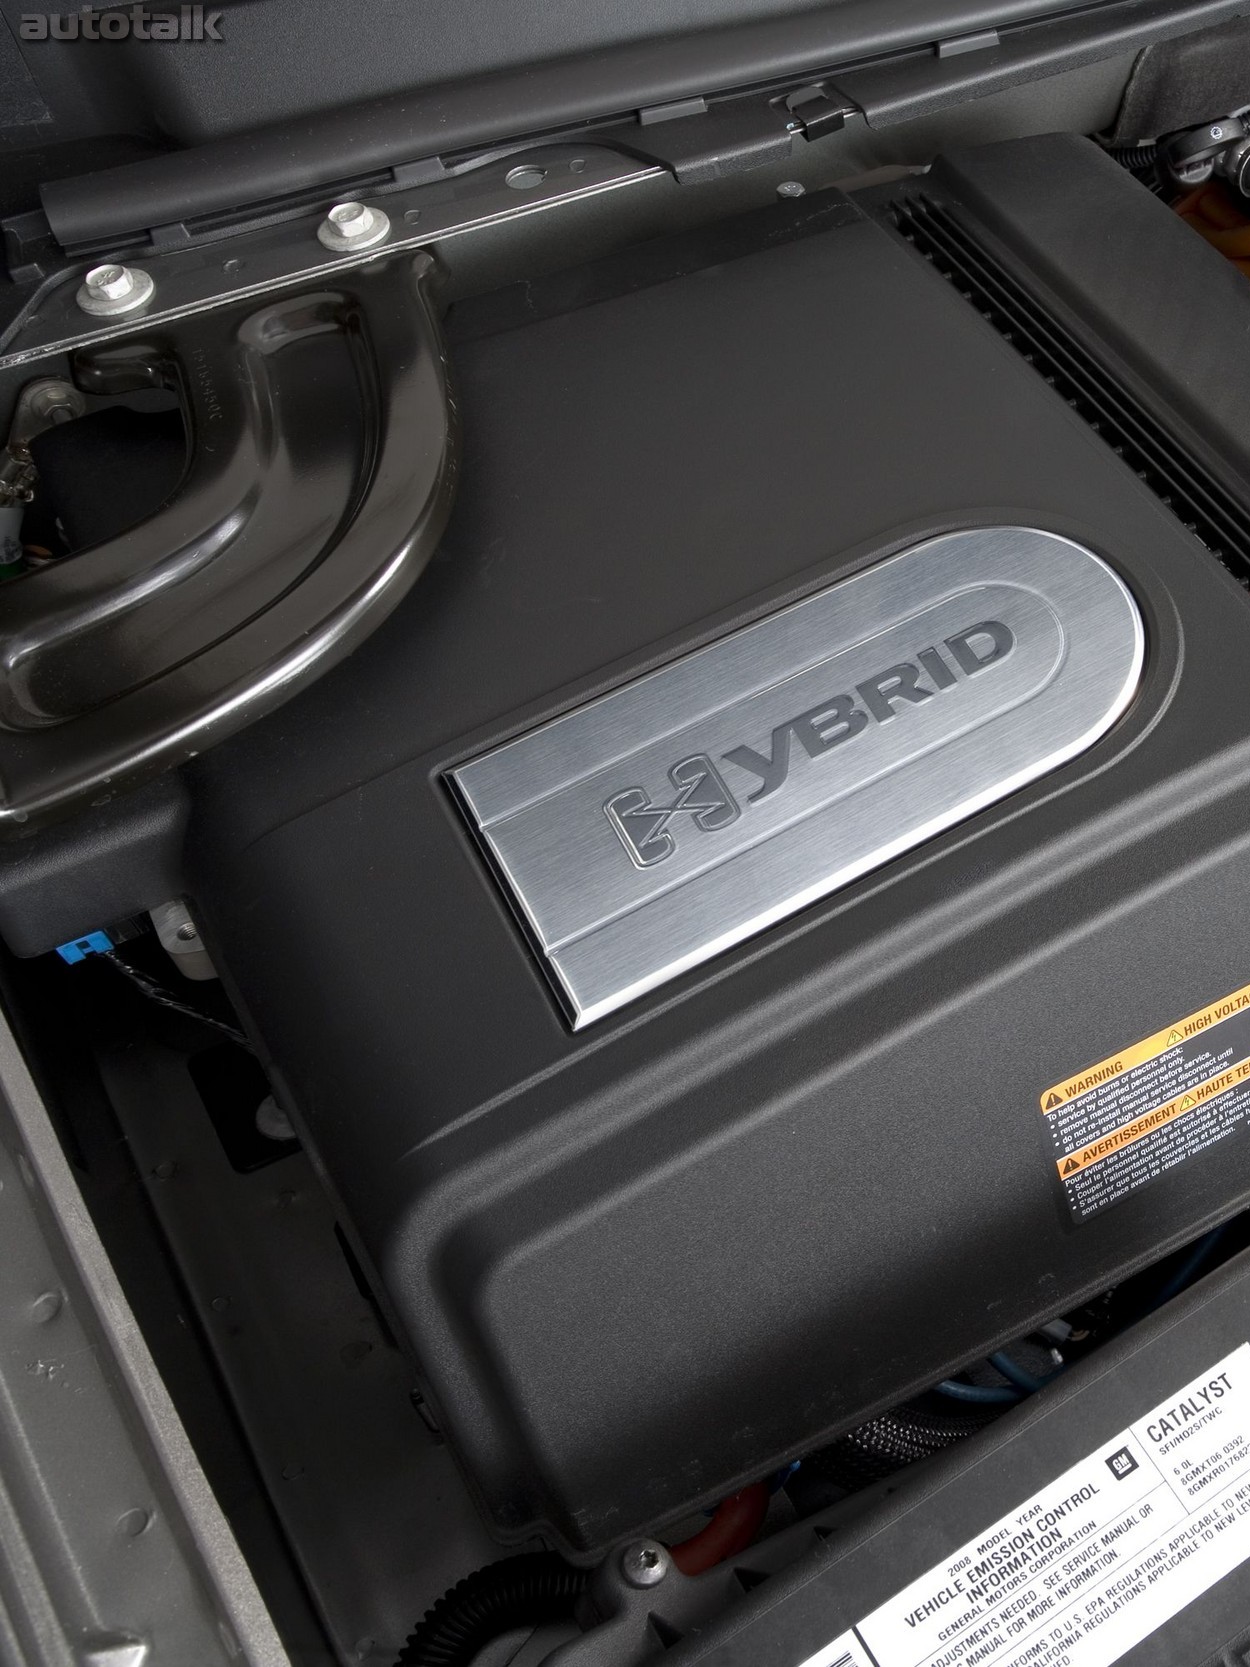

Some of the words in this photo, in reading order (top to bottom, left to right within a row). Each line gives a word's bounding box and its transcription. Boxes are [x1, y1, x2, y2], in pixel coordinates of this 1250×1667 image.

[1046, 1113, 1057, 1122] To
[1057, 1103, 1076, 1117] help
[1076, 1090, 1097, 1108] avoid
[1097, 1080, 1120, 1096] burns
[1120, 1074, 1130, 1084] or
[1130, 1060, 1159, 1079] electric
[1159, 1046, 1184, 1064] shock:
[1057, 1108, 1086, 1127] service
[1086, 1102, 1096, 1112] by
[1097, 1083, 1130, 1107] qualified
[1130, 1063, 1167, 1090] personnel
[1167, 1056, 1185, 1069] only.
[1059, 1116, 1089, 1136] remove
[1089, 1099, 1118, 1120] manual
[1118, 1078, 1159, 1105] disconnect
[1158, 1066, 1183, 1083] before
[1183, 1051, 1212, 1070] service.
[1062, 1135, 1073, 1145] do
[1073, 1126, 1087, 1139] not
[1087, 1107, 1121, 1131] re-install
[1121, 1092, 1150, 1113] manual
[1150, 1079, 1177, 1098] service
[1177, 1056, 1217, 1083] disconnect
[1217, 1047, 1234, 1062] until
[1064, 1060, 1123, 1098] WARNING
[1183, 1013, 1212, 1037] HIGH
[1064, 1142, 1075, 1153] all
[1075, 1129, 1101, 1147] covers
[1101, 1120, 1116, 1134] and
[1116, 1112, 1134, 1125] high
[1134, 1097, 1162, 1115] voltage
[1162, 1083, 1186, 1101] cables
[1186, 1076, 1199, 1088] are
[1199, 1072, 1208, 1080] in
[1208, 1060, 1230, 1077] place.
[1082, 1103, 1176, 1163] AVERTISSEMENT
[1196, 1072, 1234, 1101] HAUTE
[1146, 1372, 1232, 1443] CATALYST
[904, 1578, 966, 1628] VEHICLE
[966, 1528, 1035, 1584] EMISSION
[1036, 1483, 1101, 1532] CONTROL
[937, 1605, 985, 1641] GENERAL
[985, 1571, 1028, 1607] MOTORS
[1028, 1520, 1097, 1574] CORPORATION
[947, 1555, 972, 1578] 2008
[976, 1528, 1011, 1556] MODEL
[1015, 1504, 1043, 1526] YEAR
[965, 1527, 1063, 1604] INFORMATION
[999, 1589, 1041, 1623] NEEDED.
[1042, 1570, 1063, 1590] SEE
[1061, 1541, 1102, 1576] SERVICE
[1100, 1515, 1140, 1547] MANUAL
[1138, 1503, 1154, 1519] OR
[1048, 1628, 1063, 1642] TO
[1063, 1613, 1082, 1632] U.S.
[1084, 1596, 1106, 1615] EPA
[1104, 1548, 1168, 1600] REGULATIONS
[1168, 1509, 1221, 1553] APPLICABLE
[1221, 1498, 1235, 1511] TO
[1082, 1580, 1147, 1633] REGULATIONS
[1147, 1539, 1200, 1585] APPLICABLE
[1200, 1529, 1214, 1543] TO
[1213, 1512, 1236, 1533] NEW
[965, 1633, 1008, 1667] MANUAL
[1006, 1617, 1028, 1638] FOR
[1026, 1595, 1056, 1622] MORE
[1054, 1548, 1120, 1601] INFORMATION.
